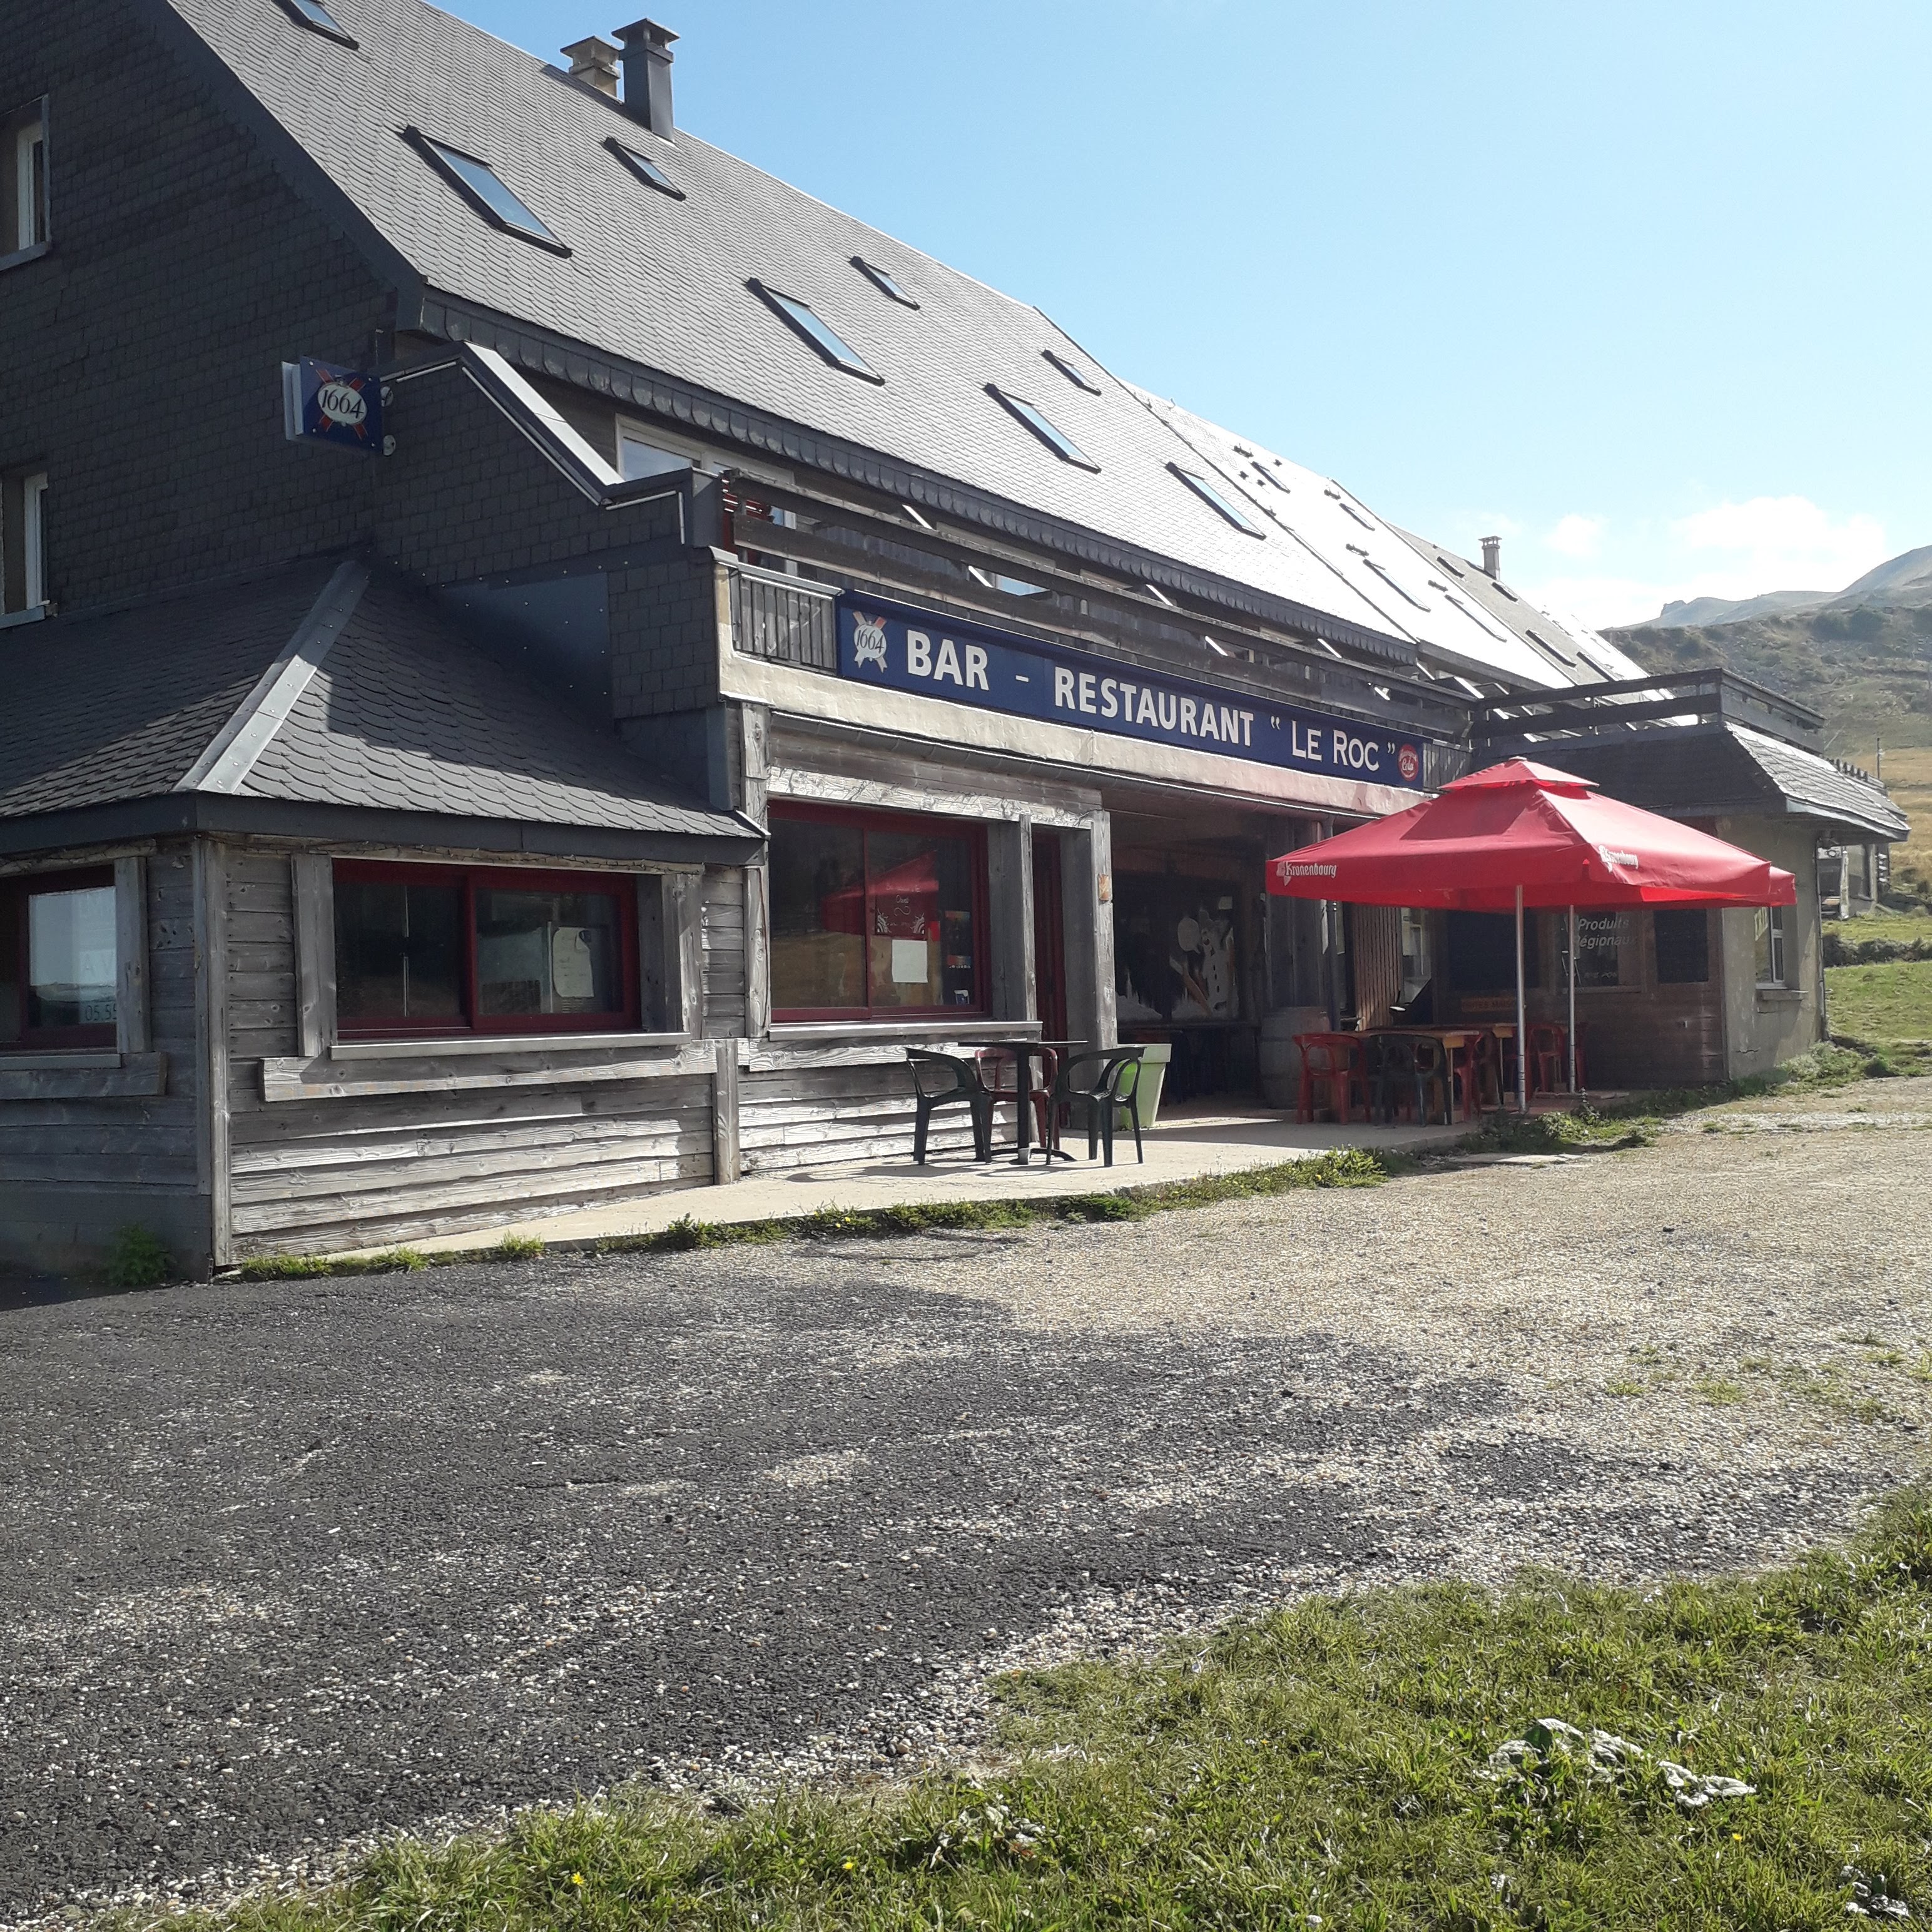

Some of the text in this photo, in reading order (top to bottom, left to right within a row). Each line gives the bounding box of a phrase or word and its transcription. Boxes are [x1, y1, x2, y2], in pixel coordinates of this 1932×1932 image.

[321, 389, 364, 419] 1664
[856, 628, 885, 654] 1664
[907, 629, 989, 691] BAR
[1055, 666, 1254, 740] RESTAURANT
[1286, 861, 1337, 878] Kronenbourg
[1579, 917, 1629, 931] Produits
